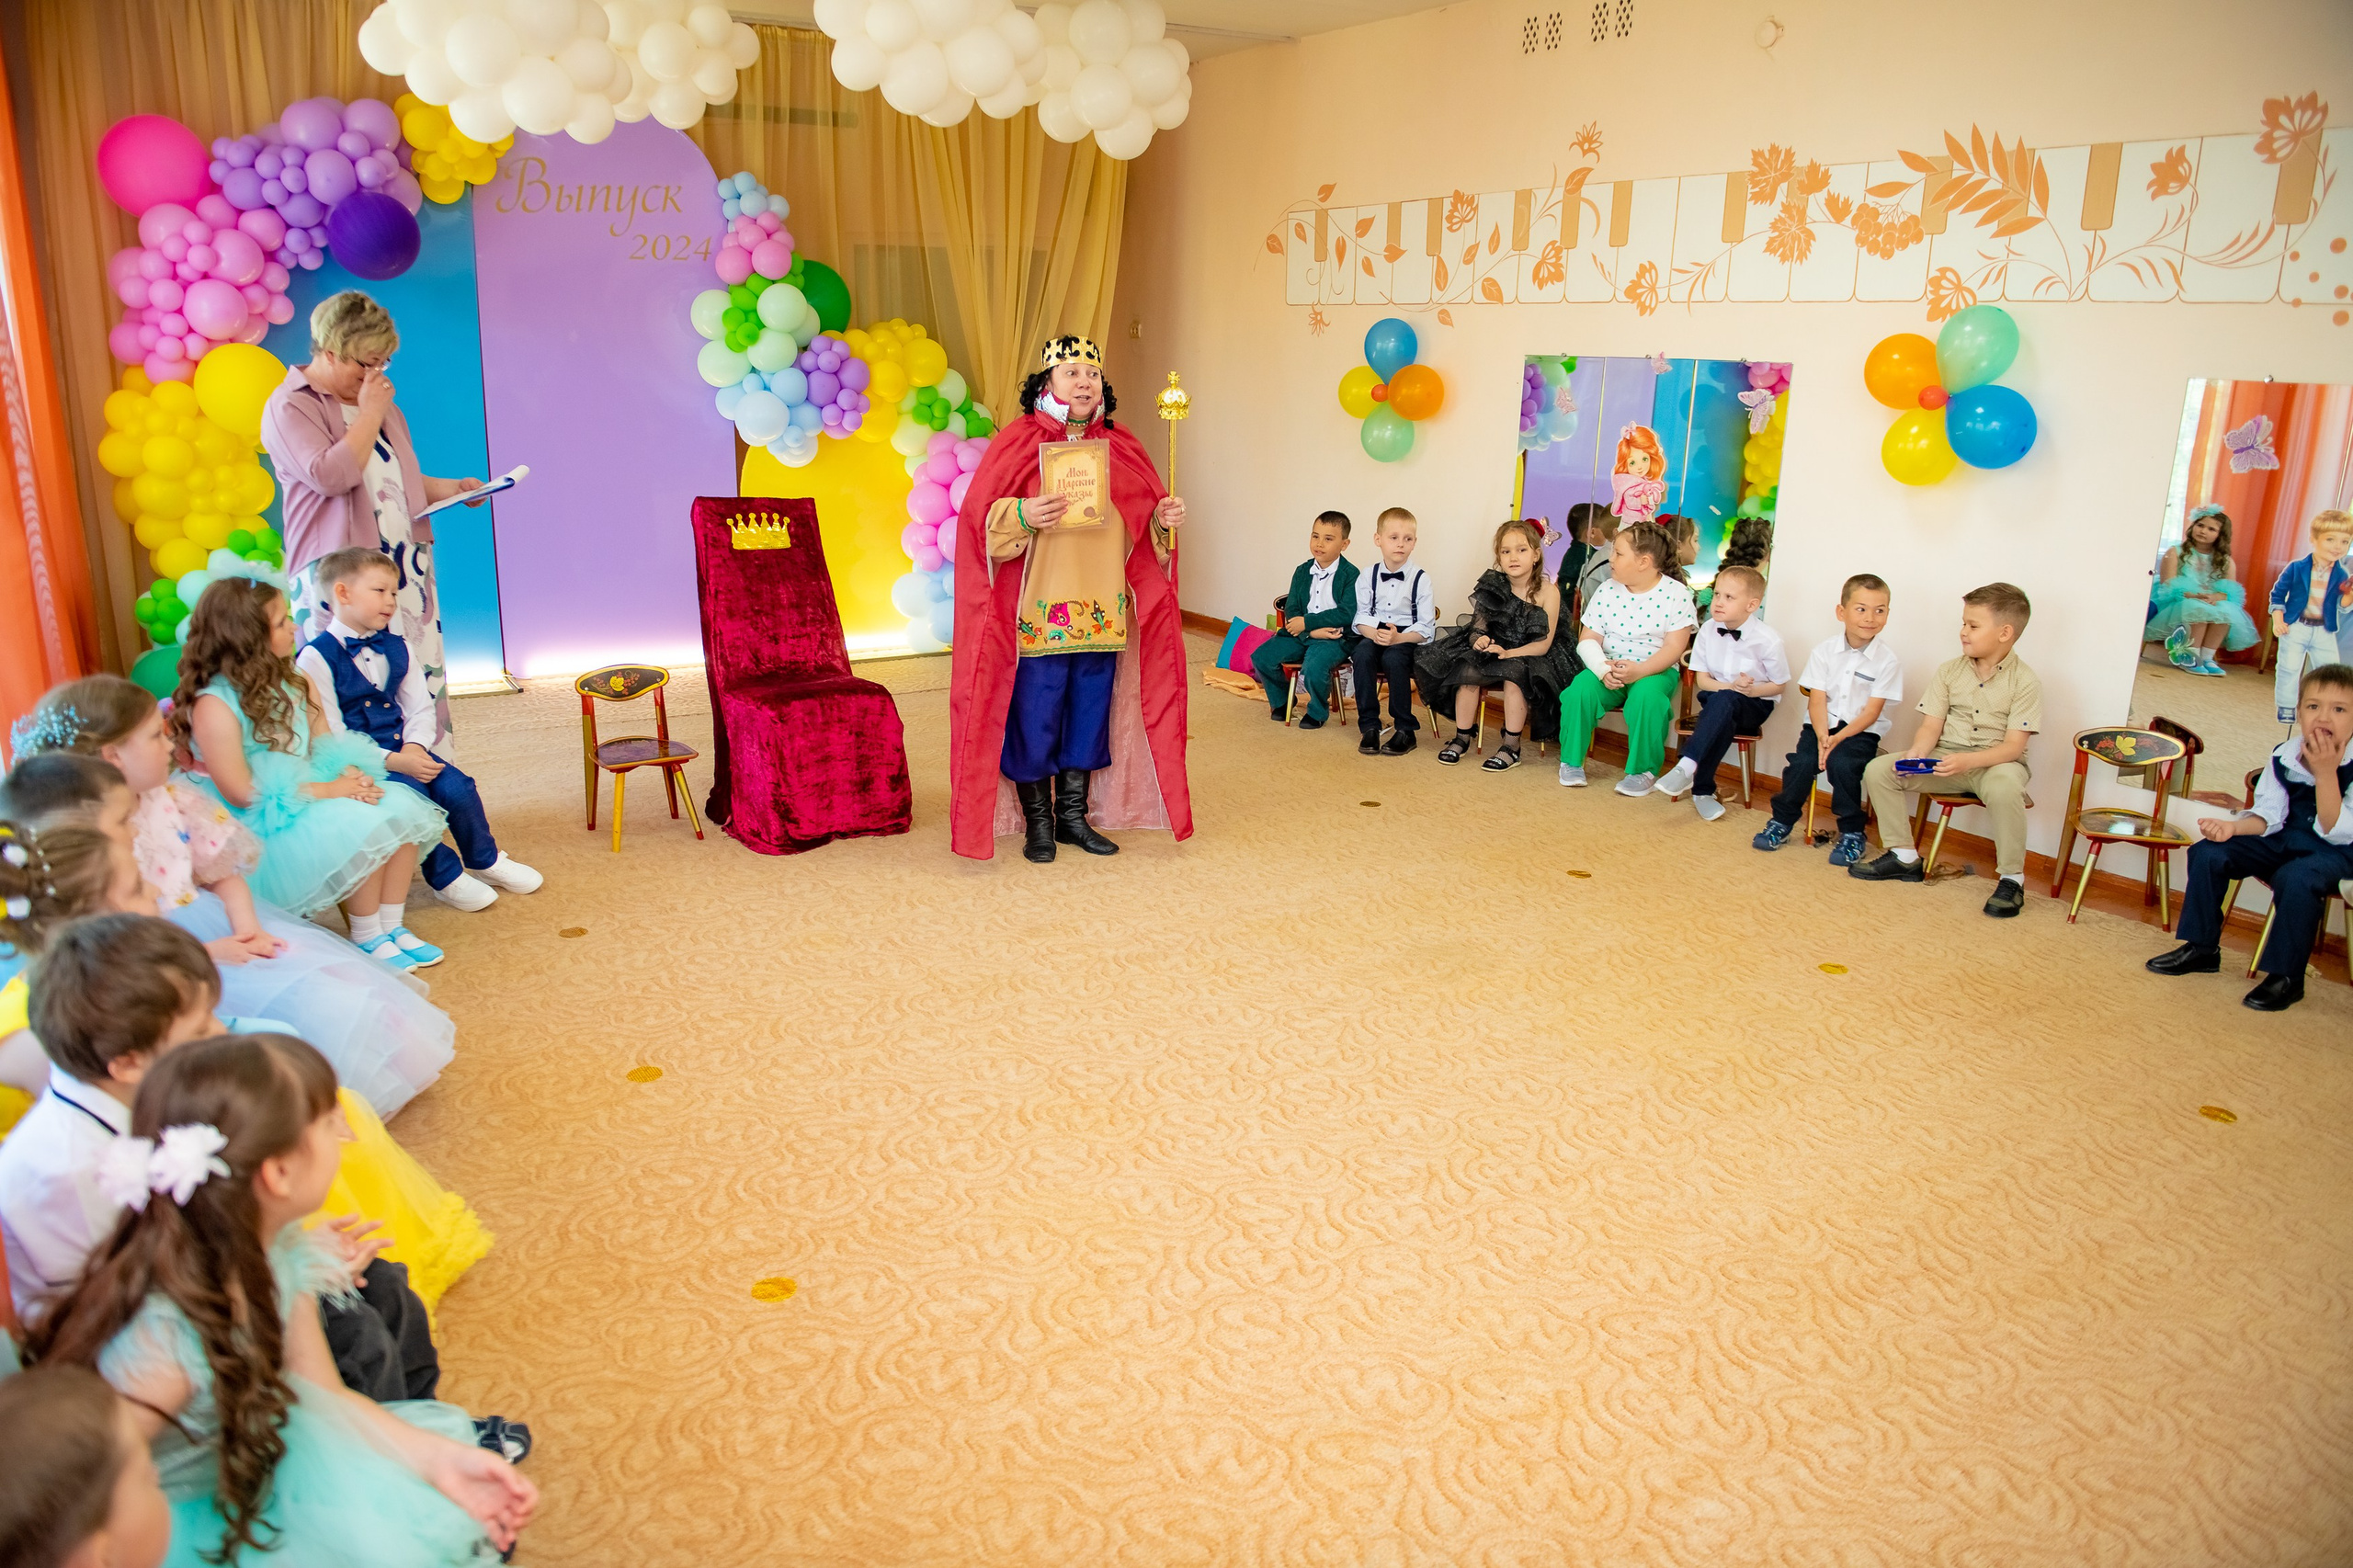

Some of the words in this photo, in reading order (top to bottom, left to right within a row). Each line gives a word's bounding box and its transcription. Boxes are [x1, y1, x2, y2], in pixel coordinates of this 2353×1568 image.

[494, 156, 683, 237] Выпуск
[629, 234, 712, 262] 2024
[1057, 478, 1097, 492] Царские
